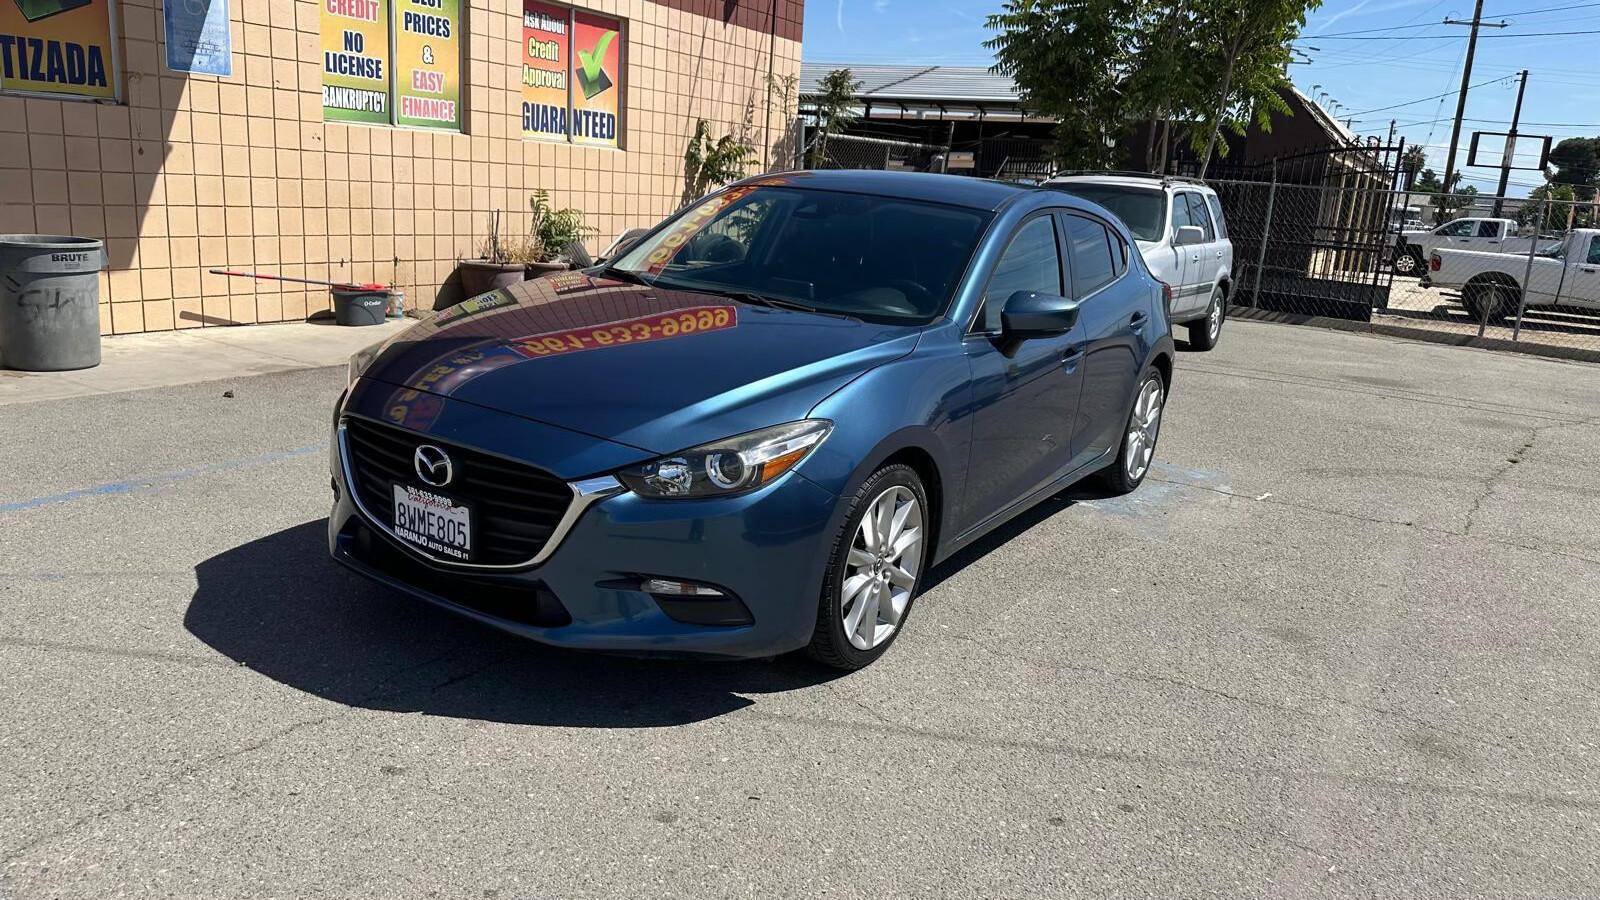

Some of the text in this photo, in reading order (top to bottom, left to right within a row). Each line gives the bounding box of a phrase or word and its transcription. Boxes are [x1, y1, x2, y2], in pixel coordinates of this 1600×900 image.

[327, 0, 379, 21] CREDIT
[523, 10, 566, 35] Ask About
[404, 11, 450, 38] PRICES
[343, 30, 364, 53] NO
[422, 44, 434, 64] &
[528, 36, 559, 62] Credit
[0, 34, 108, 87] TIZADA
[325, 52, 382, 79] LICENSE
[412, 70, 444, 92] EASY
[522, 63, 566, 90] Approval
[322, 84, 387, 113] BANKRUPTCY
[402, 96, 456, 121] FINANCE
[522, 101, 616, 139] GUARANTEED
[51, 253, 89, 262] BRUTE
[398, 502, 466, 548] 8WME805
[394, 525, 428, 547] NARANJO
[428, 541, 443, 552] AUTO
[443, 546, 462, 559] SALES
